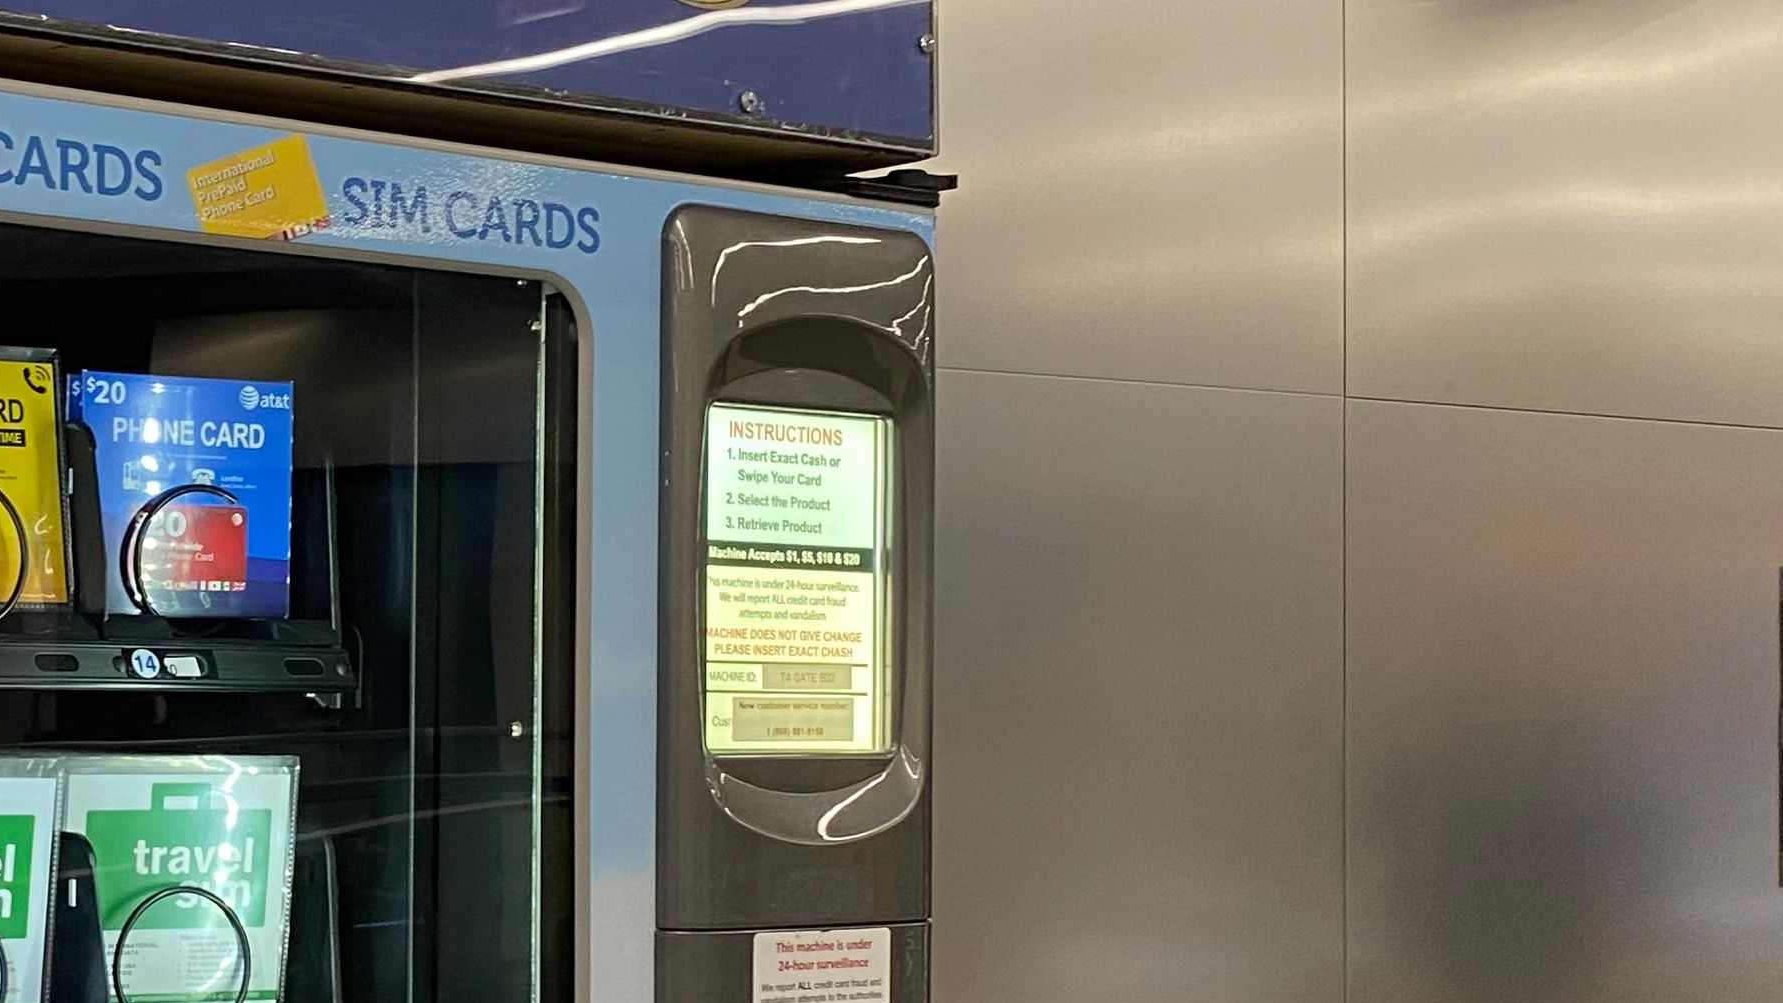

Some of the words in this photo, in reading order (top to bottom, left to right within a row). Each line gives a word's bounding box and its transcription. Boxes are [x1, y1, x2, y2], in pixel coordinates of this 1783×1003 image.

[192, 150, 276, 190] International
[198, 178, 247, 204] PrePaid
[201, 195, 243, 221] Phone
[245, 185, 276, 209] Card
[342, 176, 432, 234] SIM
[445, 190, 600, 254] CARDS
[86, 377, 127, 405] $20
[260, 391, 289, 409] at&t
[200, 421, 265, 449] CARD
[729, 420, 843, 446] INSTRUCTIONS
[727, 448, 737, 460] 1.
[739, 448, 767, 463] Insert
[770, 451, 798, 464] Exact
[801, 453, 826, 467] Cash
[830, 457, 841, 467] or
[738, 469, 768, 484] Swipe
[772, 471, 795, 484] Your
[797, 474, 821, 486] Card
[726, 492, 735, 504] 2.
[738, 493, 769, 506] Select
[772, 494, 788, 508] the
[790, 497, 831, 511] Product
[726, 517, 734, 529] 3.
[738, 517, 779, 531] Retrieve
[783, 520, 822, 533] Product
[707, 628, 748, 639] MACHINE
[750, 629, 776, 640] DOES
[778, 630, 797, 640] NOT
[800, 630, 821, 641] GIVE
[823, 632, 862, 643] CHANGE
[715, 644, 750, 655] PLEASE
[753, 644, 786, 656] INSERT
[789, 645, 819, 656] EXACT
[821, 646, 853, 657] CHASH
[135, 654, 157, 674] 14
[133, 837, 254, 876] travel
[776, 943, 794, 953] This
[797, 941, 834, 952] machine
[837, 940, 843, 950] is
[846, 939, 872, 950] under
[778, 960, 814, 971] 24-hour
[817, 958, 869, 970] surveillance
